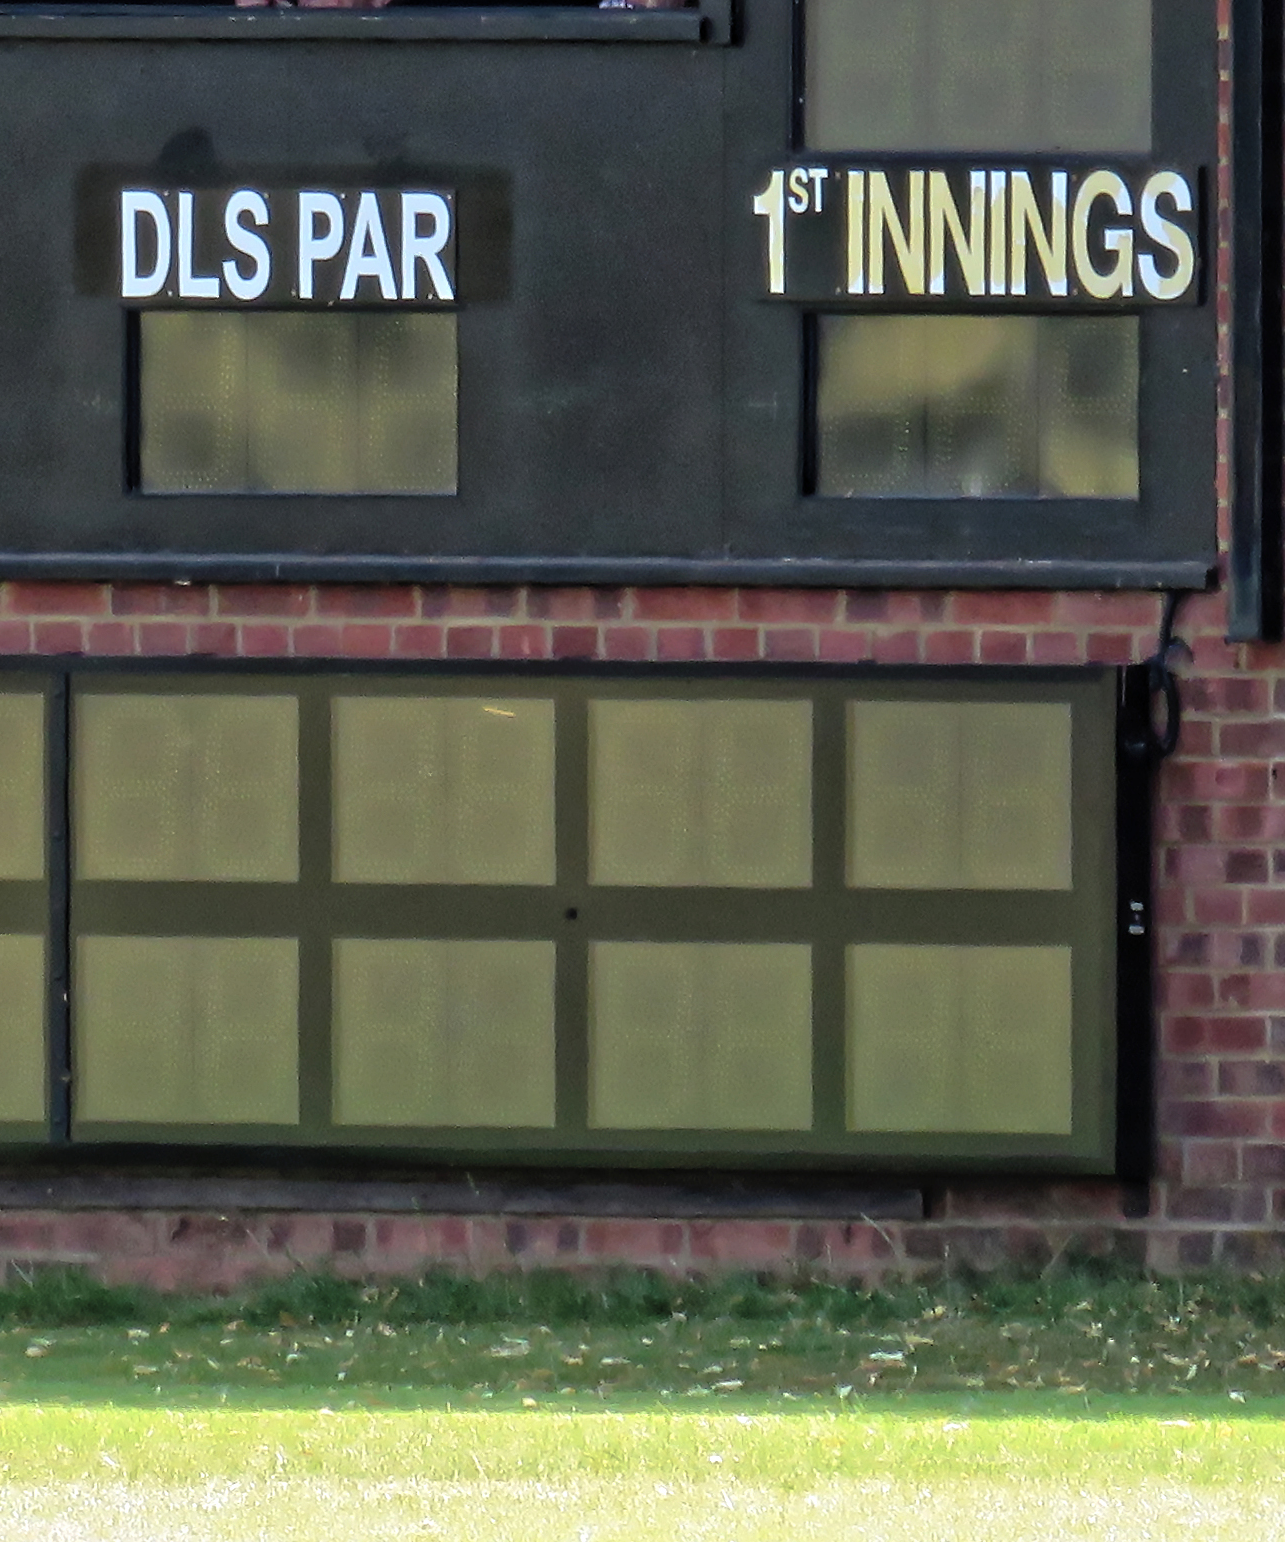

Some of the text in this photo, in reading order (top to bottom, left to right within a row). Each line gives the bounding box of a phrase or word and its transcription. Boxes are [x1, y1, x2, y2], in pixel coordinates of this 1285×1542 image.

[122, 190, 454, 299] DLS PAR
[848, 171, 1193, 299] INNINGS
